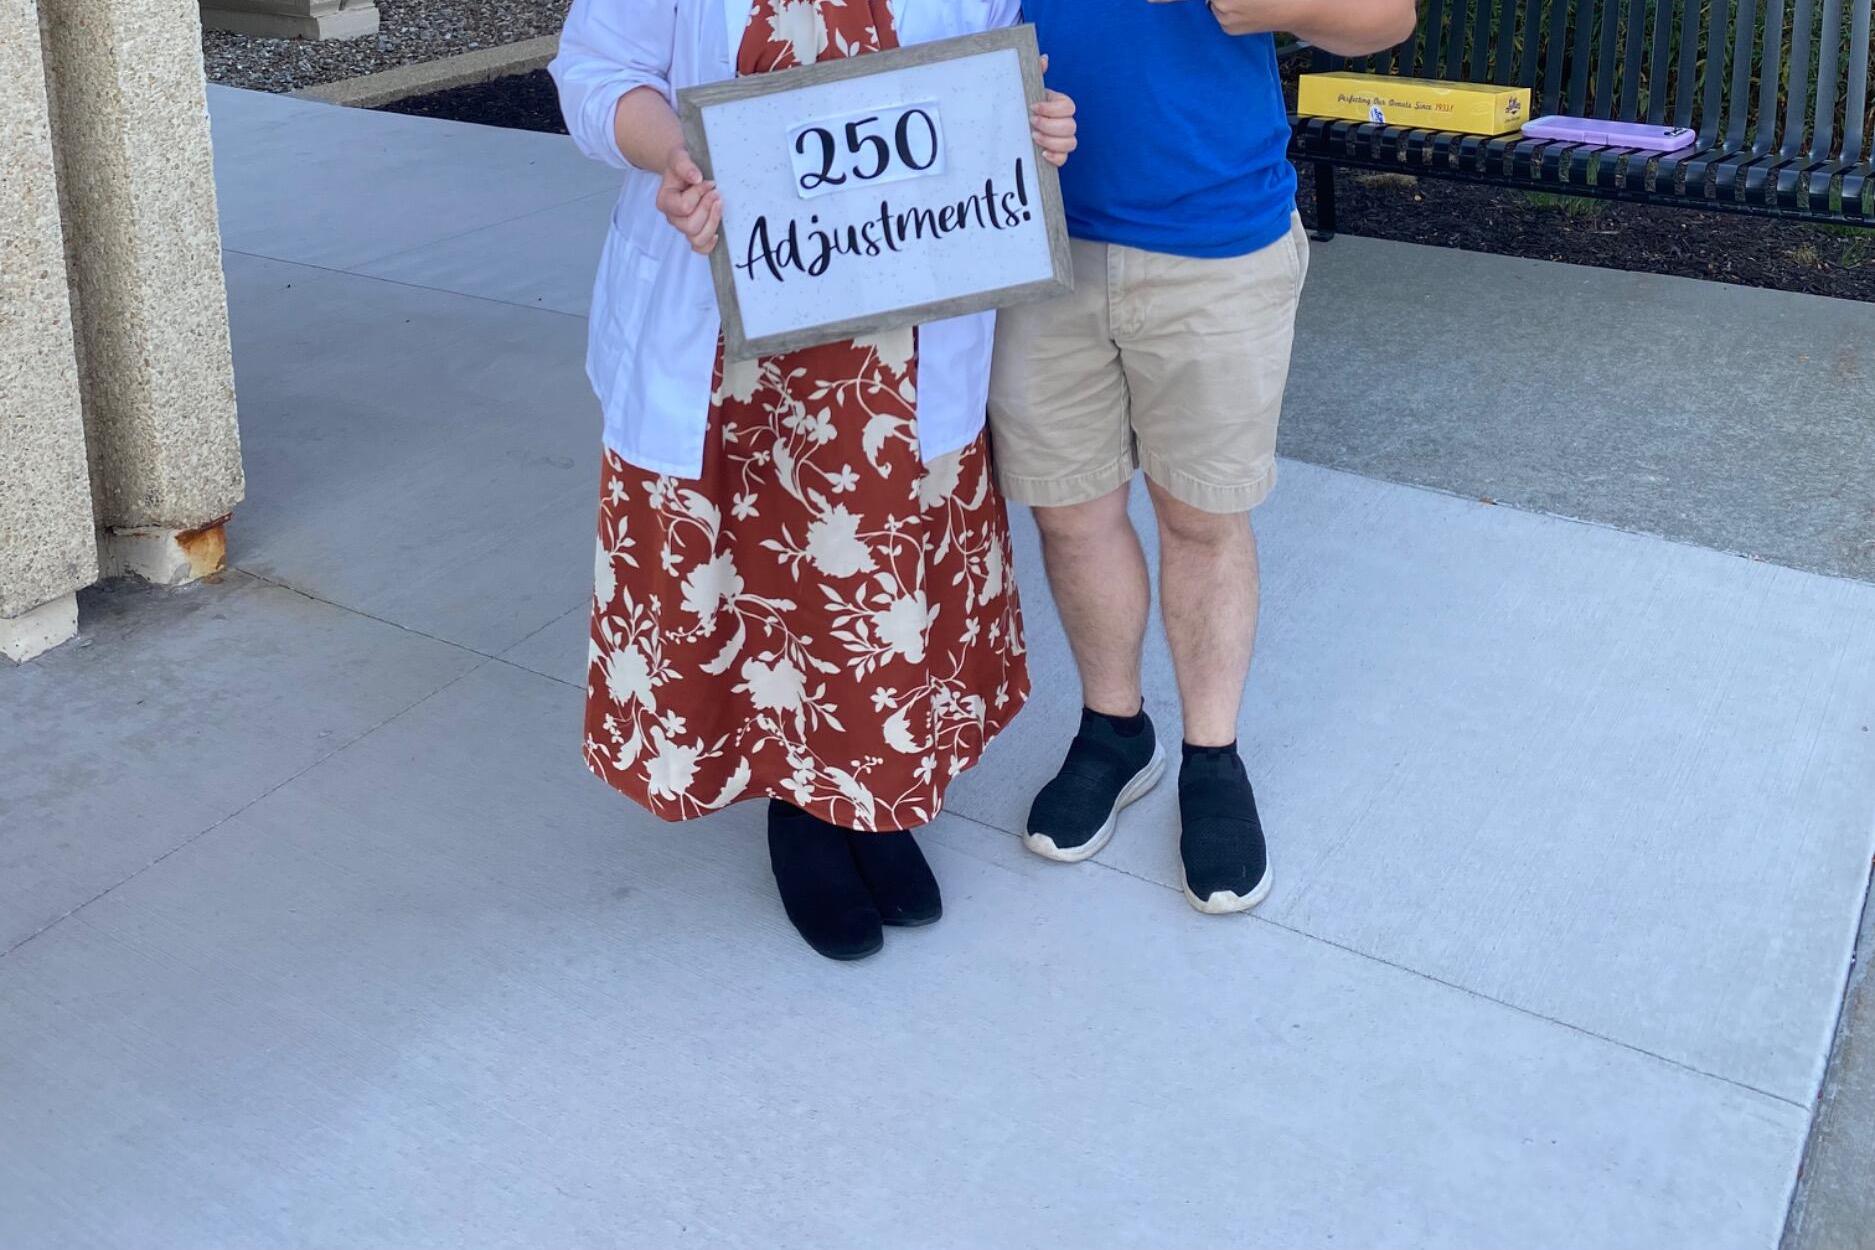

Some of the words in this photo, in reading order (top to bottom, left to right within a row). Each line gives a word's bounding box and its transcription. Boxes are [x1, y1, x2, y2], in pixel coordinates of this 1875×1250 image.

[1338, 93, 1371, 106] Perfecting
[1373, 97, 1386, 105] Our
[1388, 99, 1412, 108] Donuts
[1414, 101, 1433, 110] Since
[794, 108, 939, 190] 250
[735, 157, 1032, 283] Adjustments!
